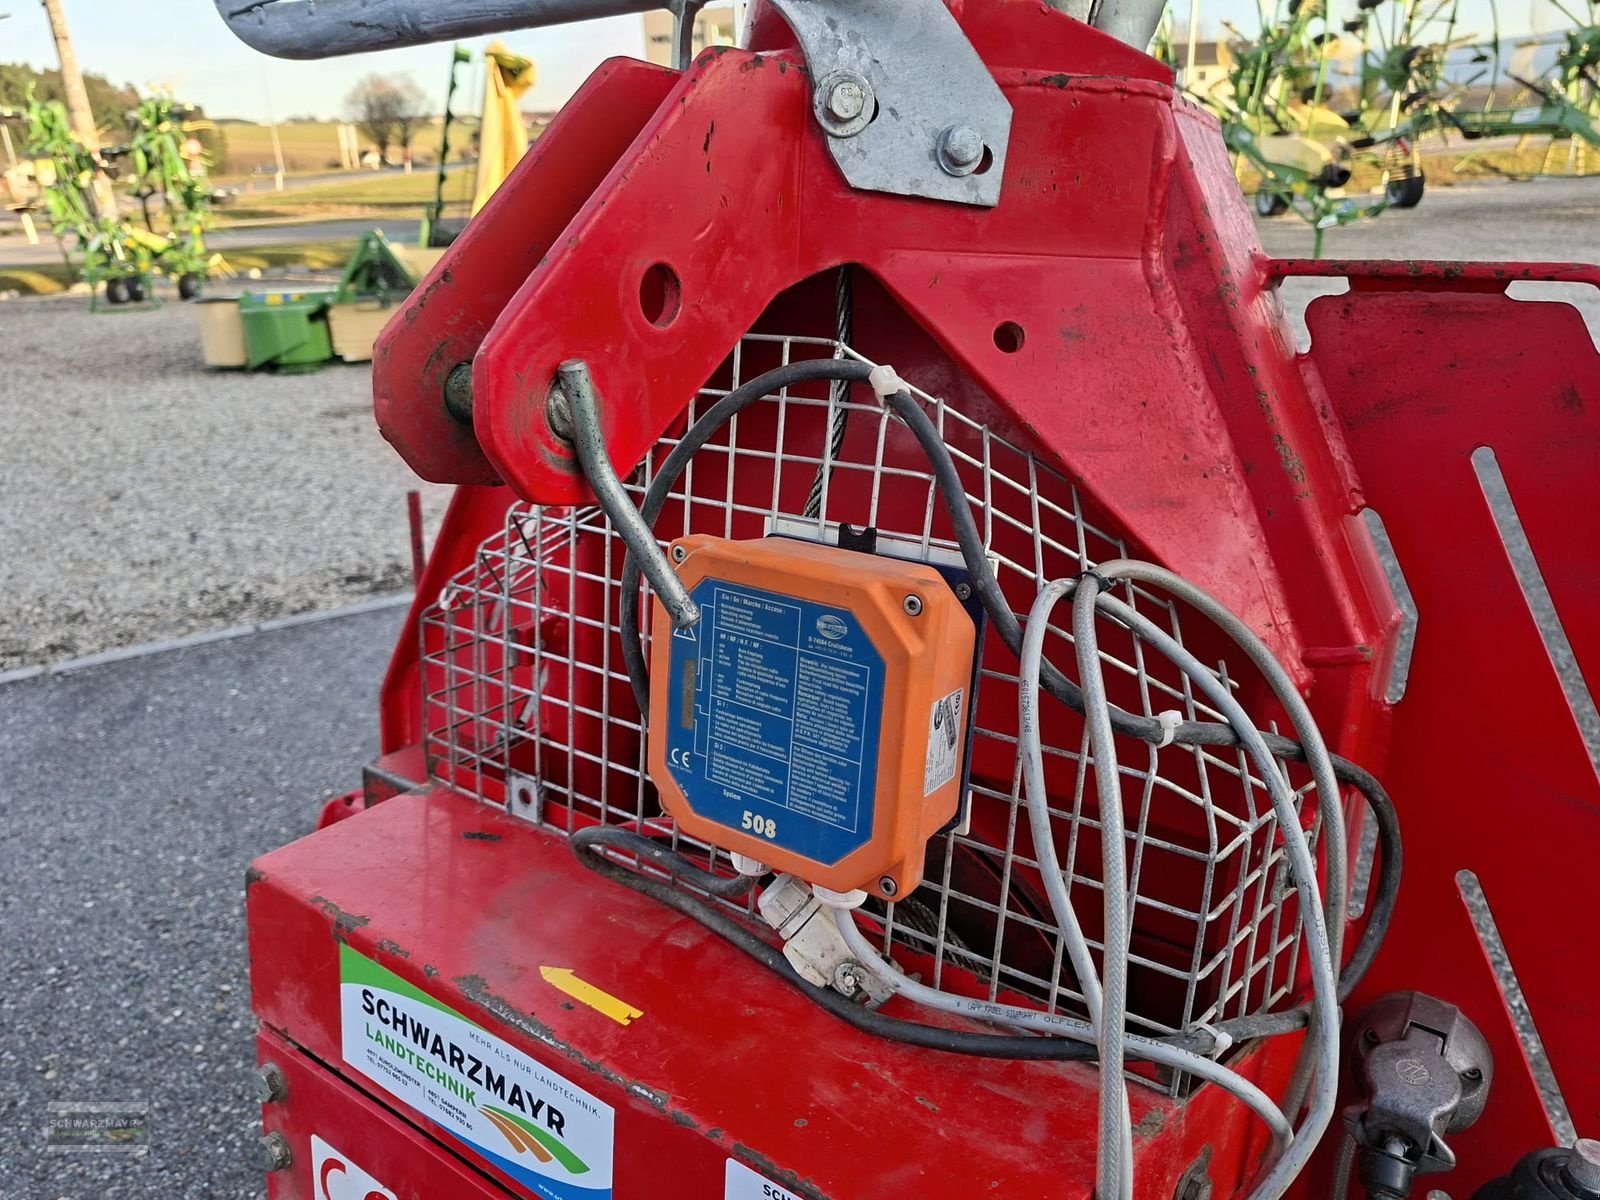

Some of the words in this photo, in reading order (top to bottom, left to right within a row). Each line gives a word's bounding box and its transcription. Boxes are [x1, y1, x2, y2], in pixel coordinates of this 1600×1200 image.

[723, 788, 742, 802] System
[742, 810, 777, 839] 508
[361, 988, 565, 1138] SCHWARZMAYR
[365, 1022, 477, 1108] LANDTECHNIK
[469, 1031, 492, 1050] MEHR
[494, 1047, 511, 1063] ALS
[513, 1059, 532, 1076] NUR
[534, 1072, 601, 1119] LANDTECHNIK.
